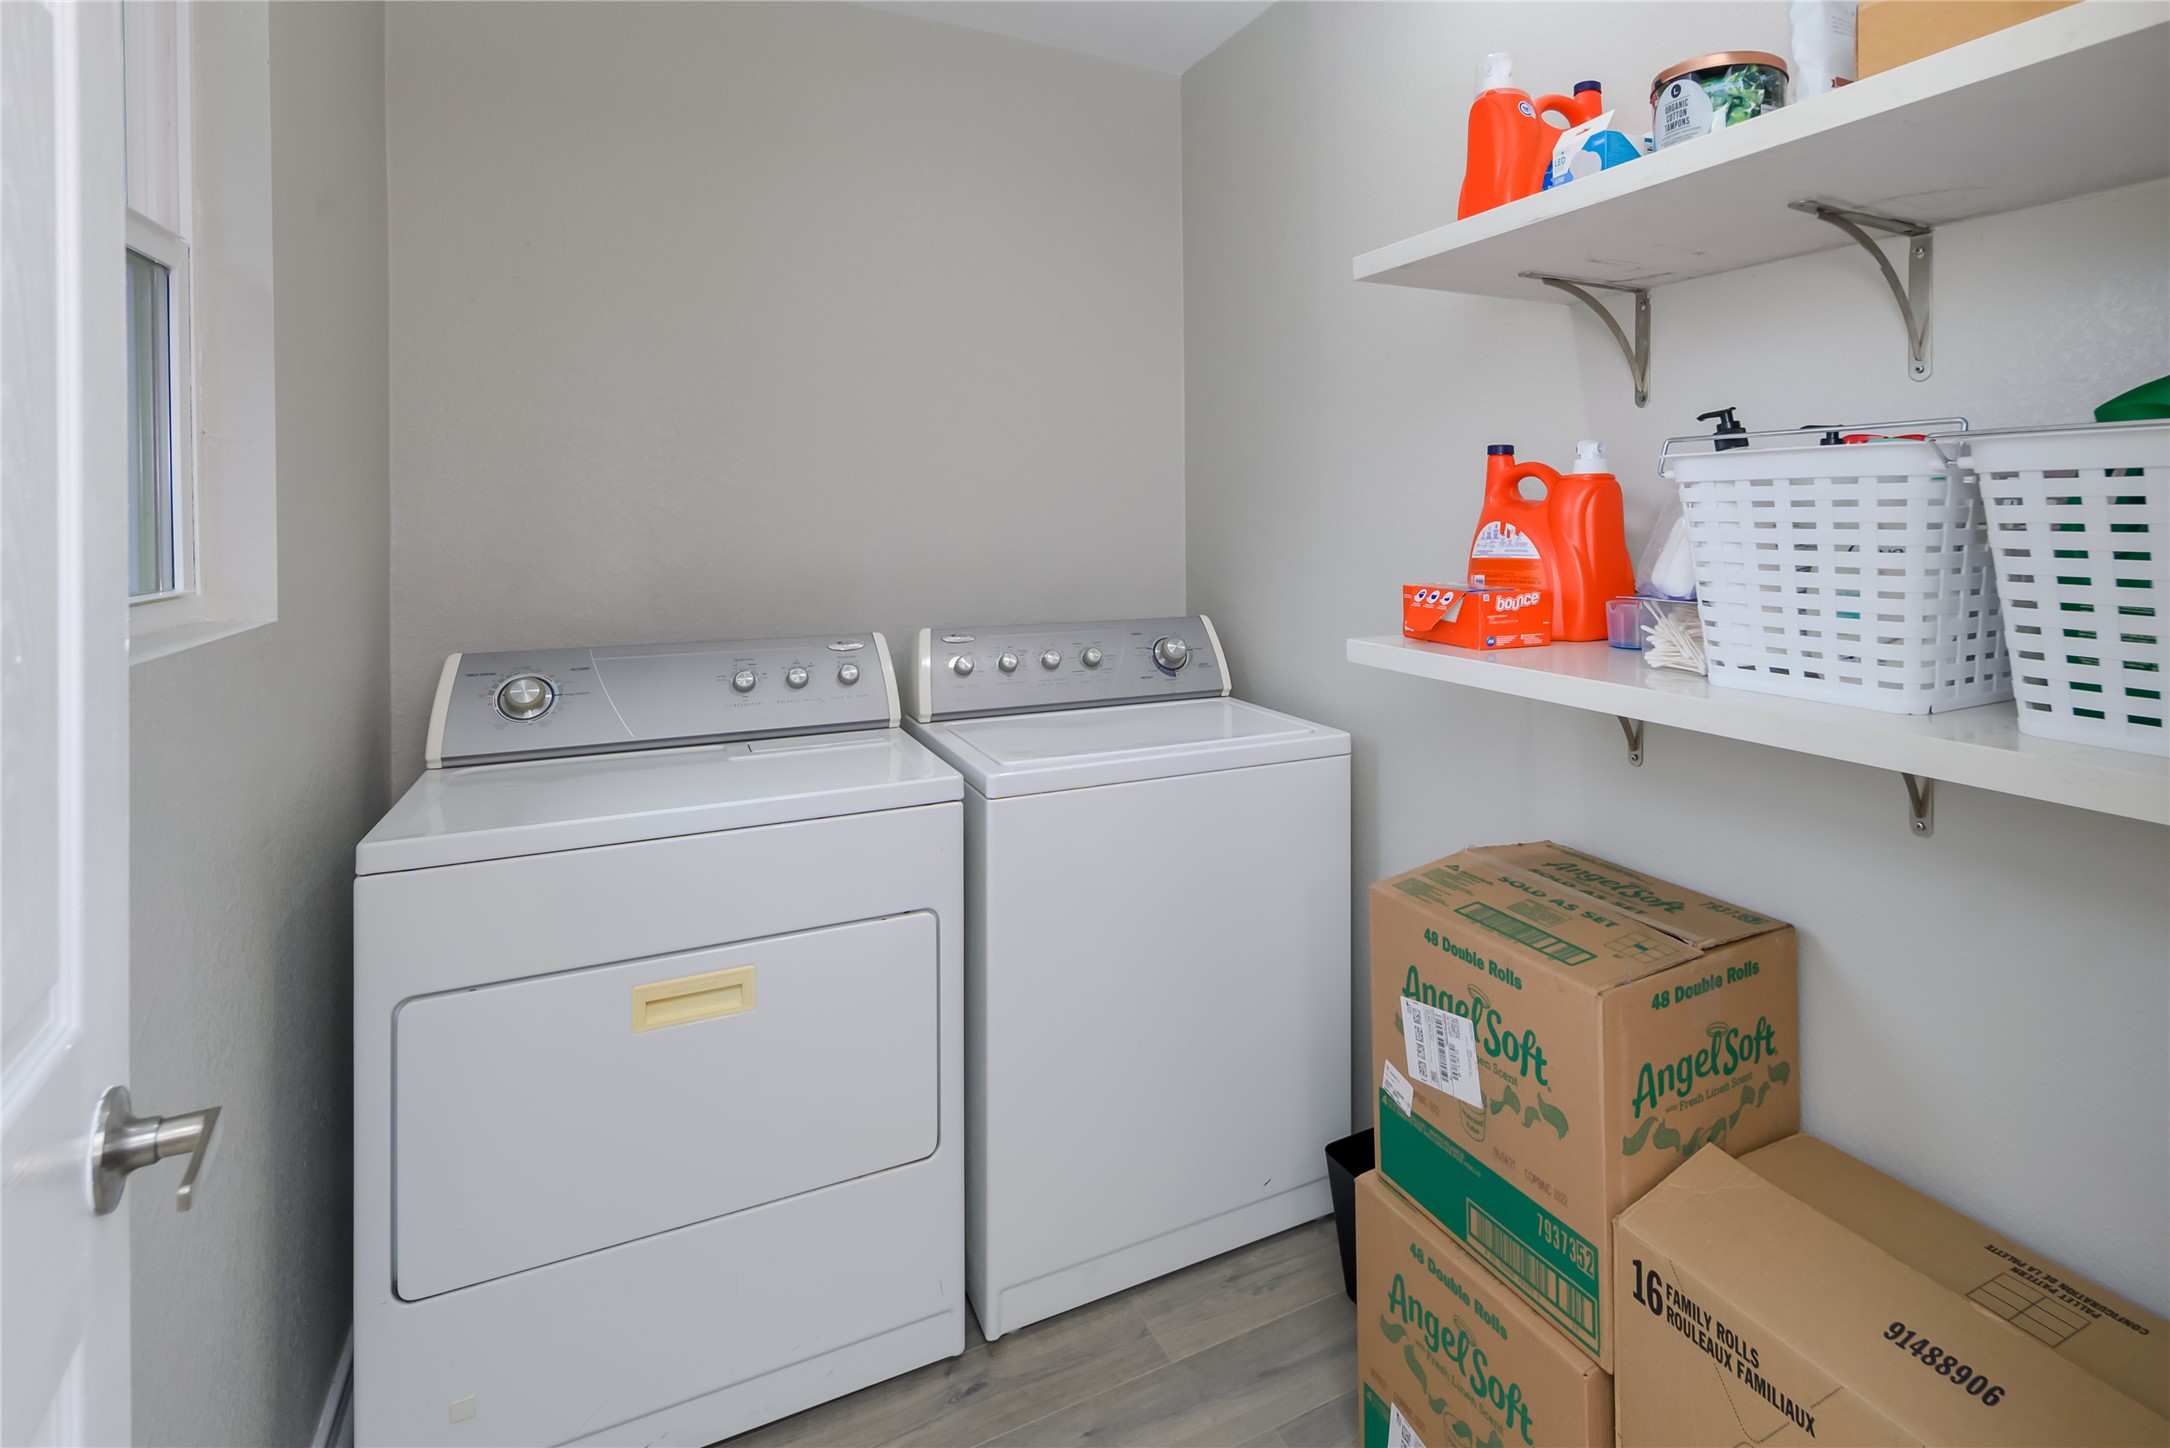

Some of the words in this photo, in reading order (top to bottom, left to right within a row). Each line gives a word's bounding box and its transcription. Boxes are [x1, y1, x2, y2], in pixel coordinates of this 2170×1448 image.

[1664, 116, 1690, 133] TAMPONS
[1665, 98, 1688, 114] ORGANIC
[1666, 108, 1687, 123] COTTON
[1554, 156, 1566, 167] LED
[1495, 592, 1540, 612] bounce
[1498, 875, 1547, 897] SOLD
[1548, 899, 1579, 911] AS
[1580, 911, 1619, 928] SET
[1541, 862, 1638, 890] Angel
[1618, 886, 1685, 915] Soft
[1424, 928, 1438, 947] 48
[1442, 936, 1485, 970] Double
[1488, 959, 1523, 990] Rolls
[1652, 990, 1670, 1010] 48
[1674, 974, 1723, 1003] Double
[1727, 960, 1760, 984] Rolls
[1483, 1009, 1548, 1086] Soft
[1632, 1030, 1722, 1119] Angel
[1723, 1016, 1776, 1076] Soft
[1492, 1063, 1518, 1088] Scent
[1679, 1094, 1704, 1111] Fresh
[1706, 1082, 1730, 1100] Linen
[1731, 1071, 1753, 1088] Scent
[1537, 1212, 1595, 1279] 7937352
[1984, 1243, 2027, 1268] PALETTE
[2027, 1266, 2042, 1275] LA
[1409, 1242, 1424, 1265] 48
[1428, 1257, 1471, 1306] Double
[1474, 1298, 1508, 1341] Rolls
[2010, 1266, 2058, 1294] PATTERN
[2042, 1274, 2059, 1284] DE
[1632, 1259, 1663, 1316] 16
[1666, 1282, 1712, 1332] FAMILY
[1716, 1320, 1760, 1369] ROLLS
[2058, 1293, 2102, 1319] PALLET
[2058, 1283, 2150, 1336] CONFIGURATION
[1388, 1273, 1469, 1377] Angel
[1469, 1348, 1534, 1446] Soft
[1666, 1304, 1733, 1373] ROULEAUX
[1736, 1359, 1816, 1438] FAMILIAUX
[1883, 1321, 2006, 1407] 91488906
[1426, 1350, 1450, 1381] Fresh
[1451, 1374, 1481, 1412] Linen
[1479, 1403, 1504, 1436] Scent
